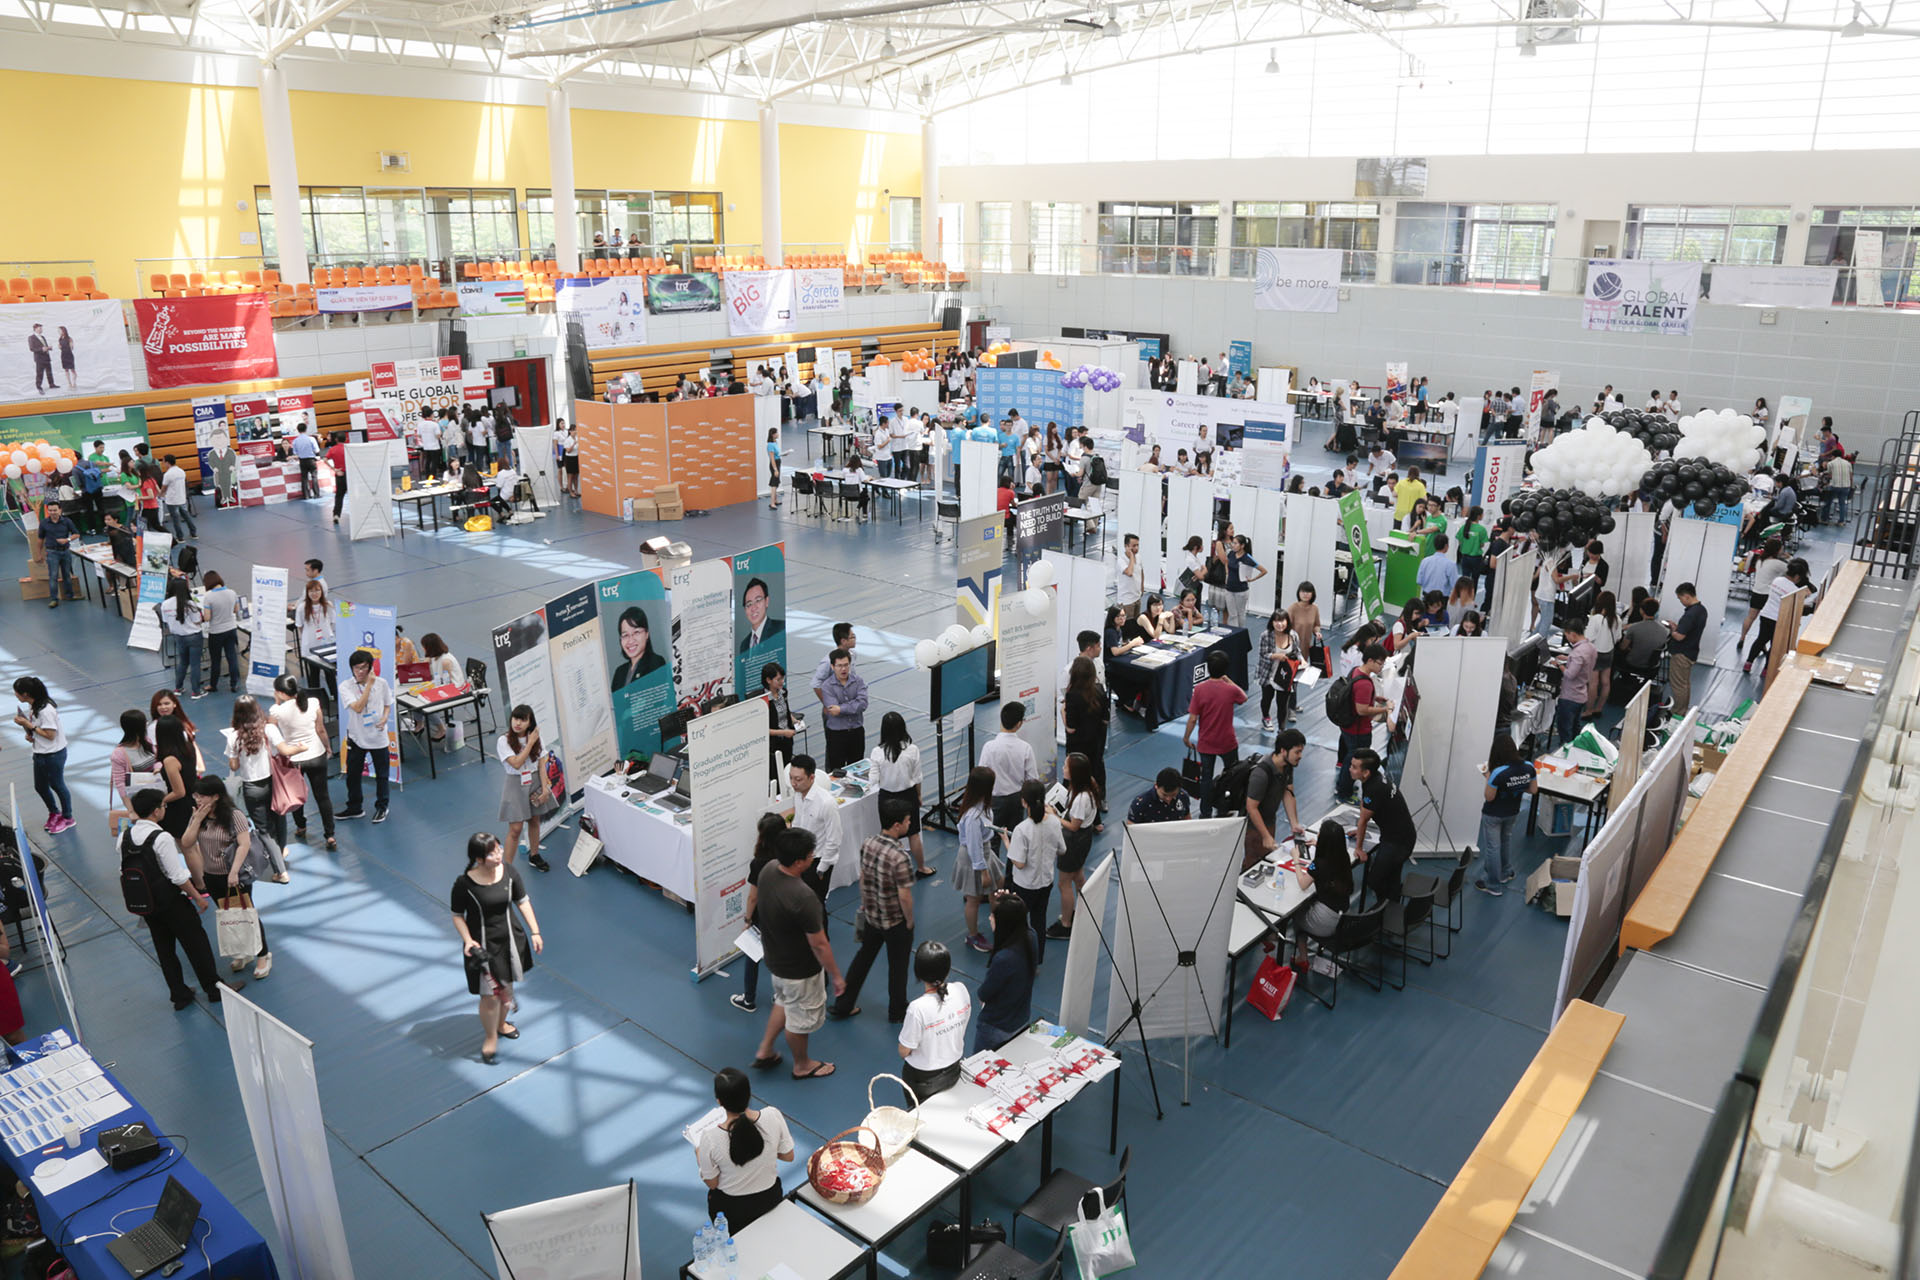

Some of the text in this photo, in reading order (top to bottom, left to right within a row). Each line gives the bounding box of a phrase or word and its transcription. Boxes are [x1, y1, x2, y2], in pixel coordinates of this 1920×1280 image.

[675, 280, 691, 293] trg
[1276, 276, 1292, 288] be
[1623, 289, 1689, 305] GLOBAL
[1622, 304, 1688, 319] TALENT
[1636, 320, 1660, 328] GLOBAL
[1661, 321, 1687, 329] CAREER
[202, 332, 246, 341] ARE MANY
[169, 339, 248, 354] POSSIBILITIES
[375, 371, 394, 379] ACCA
[420, 366, 439, 377] THE
[442, 365, 459, 373] ACCA
[409, 384, 459, 400] GLOBAL
[233, 403, 251, 413] CIA
[279, 398, 302, 406] ACCA
[430, 395, 460, 410] FOR
[194, 406, 215, 417] CMA
[1487, 456, 1501, 503] BOSCH
[1020, 503, 1063, 520] THE TRUTH YOU
[1020, 512, 1062, 530] NEED TO BUILD
[1020, 523, 1048, 538] A BIG LIFE
[736, 556, 751, 571] trg
[255, 577, 284, 587] WANTED
[673, 569, 692, 586] trg
[602, 582, 621, 597] trg
[495, 627, 512, 647] trg
[691, 724, 708, 741] trg
[693, 735, 767, 770] Graduate Development
[693, 759, 732, 779] Programme
